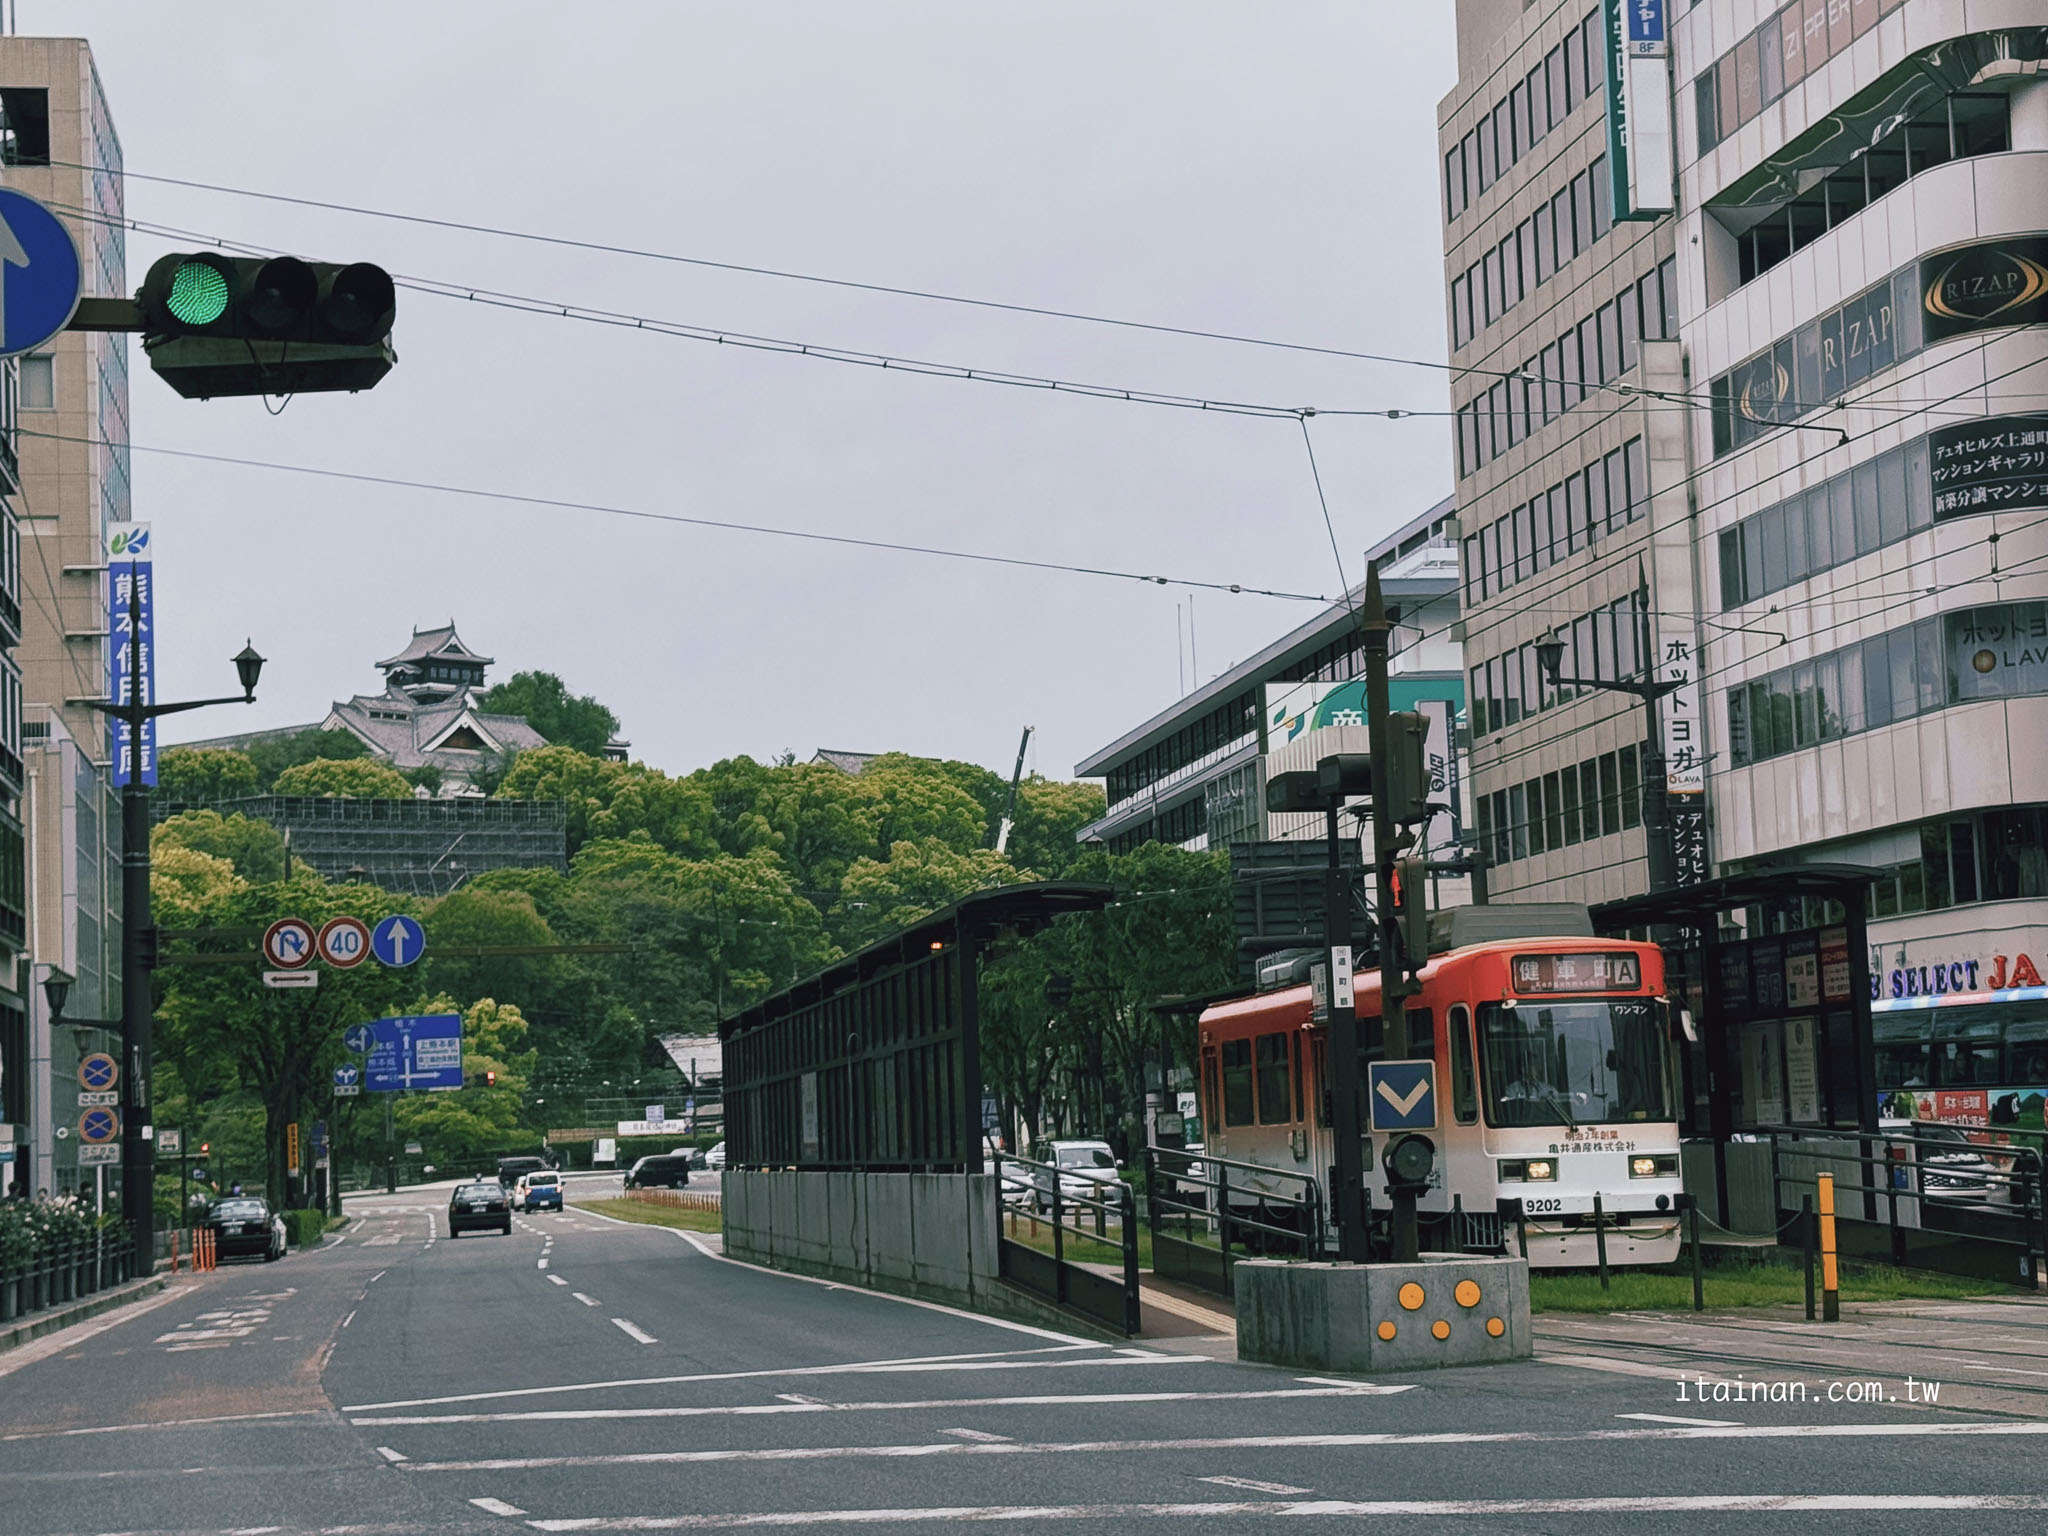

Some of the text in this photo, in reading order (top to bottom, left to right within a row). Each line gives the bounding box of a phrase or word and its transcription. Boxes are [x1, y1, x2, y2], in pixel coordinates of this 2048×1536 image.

[1639, 42, 1655, 53] 8F
[1947, 272, 2018, 300] RIZAP
[1823, 305, 1892, 373] RIZAP
[1932, 451, 2048, 482] マンションギャラリ
[1666, 640, 1695, 769] ホットヨガ
[1678, 774, 1701, 784] LAVA
[1674, 814, 1689, 888] マンション
[331, 931, 358, 954] 40
[1618, 961, 1634, 982] A
[1888, 959, 1979, 999] SELECT
[1987, 953, 2048, 990] JA
[1615, 1005, 1648, 1015] ワンマン
[1565, 1130, 1619, 1141] 明治2年創業
[1549, 1141, 1636, 1154] 亀井通産株式会社
[1526, 1199, 1562, 1213] 9202
